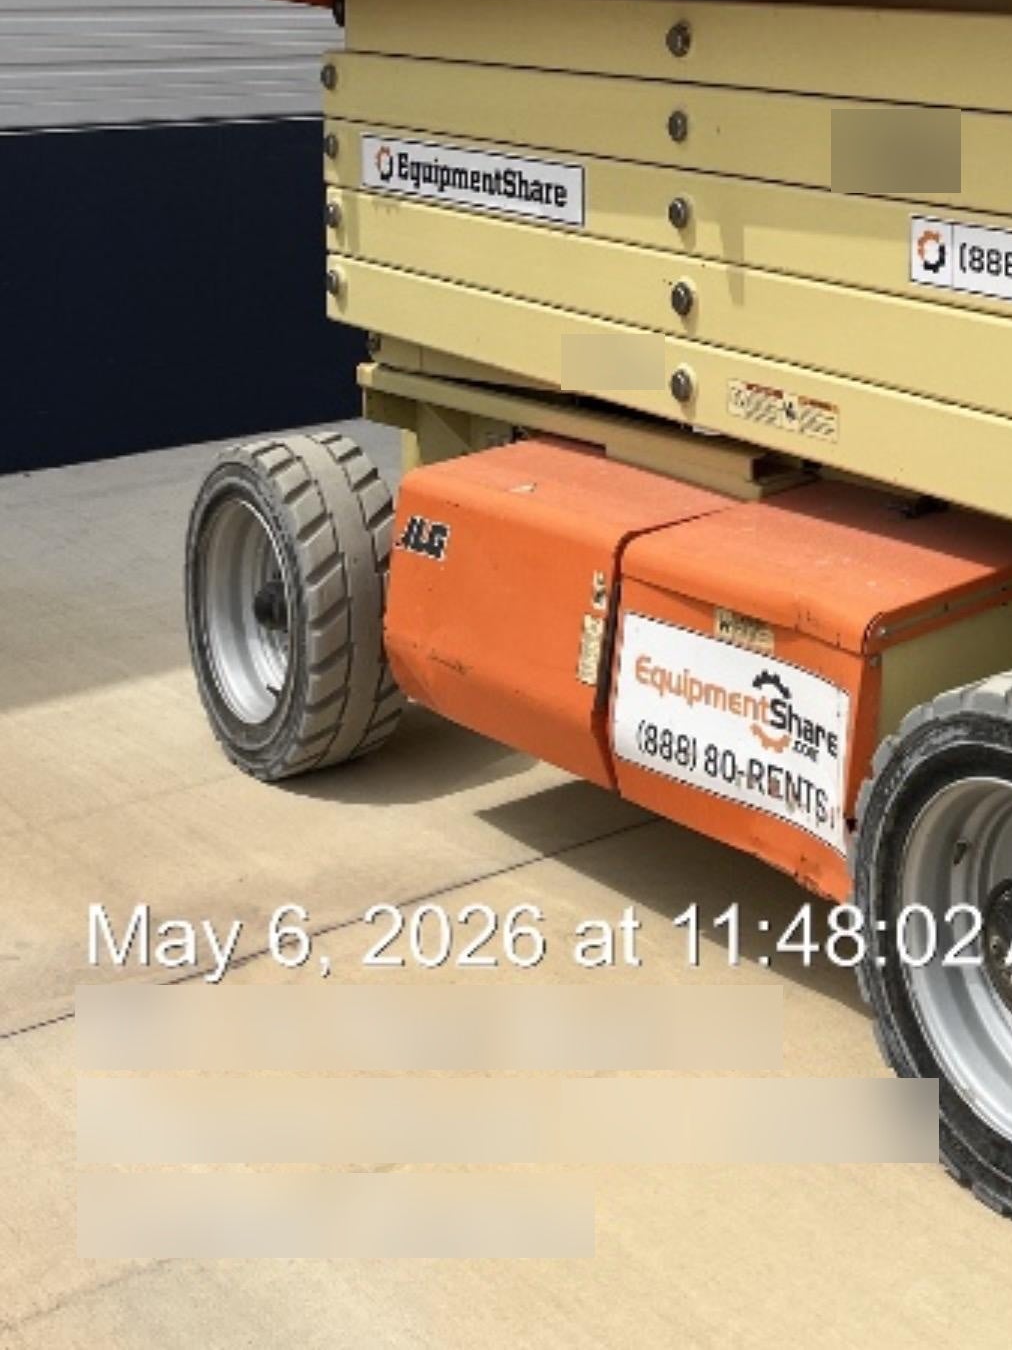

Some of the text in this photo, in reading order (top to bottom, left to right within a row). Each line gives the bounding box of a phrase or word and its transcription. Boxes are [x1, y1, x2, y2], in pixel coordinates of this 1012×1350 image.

[397, 152, 568, 208] EquipmentShare
[396, 515, 450, 561] JLG
[634, 653, 839, 760] EquipmentShare
[637, 719, 830, 826] (888) 80-RENTS
